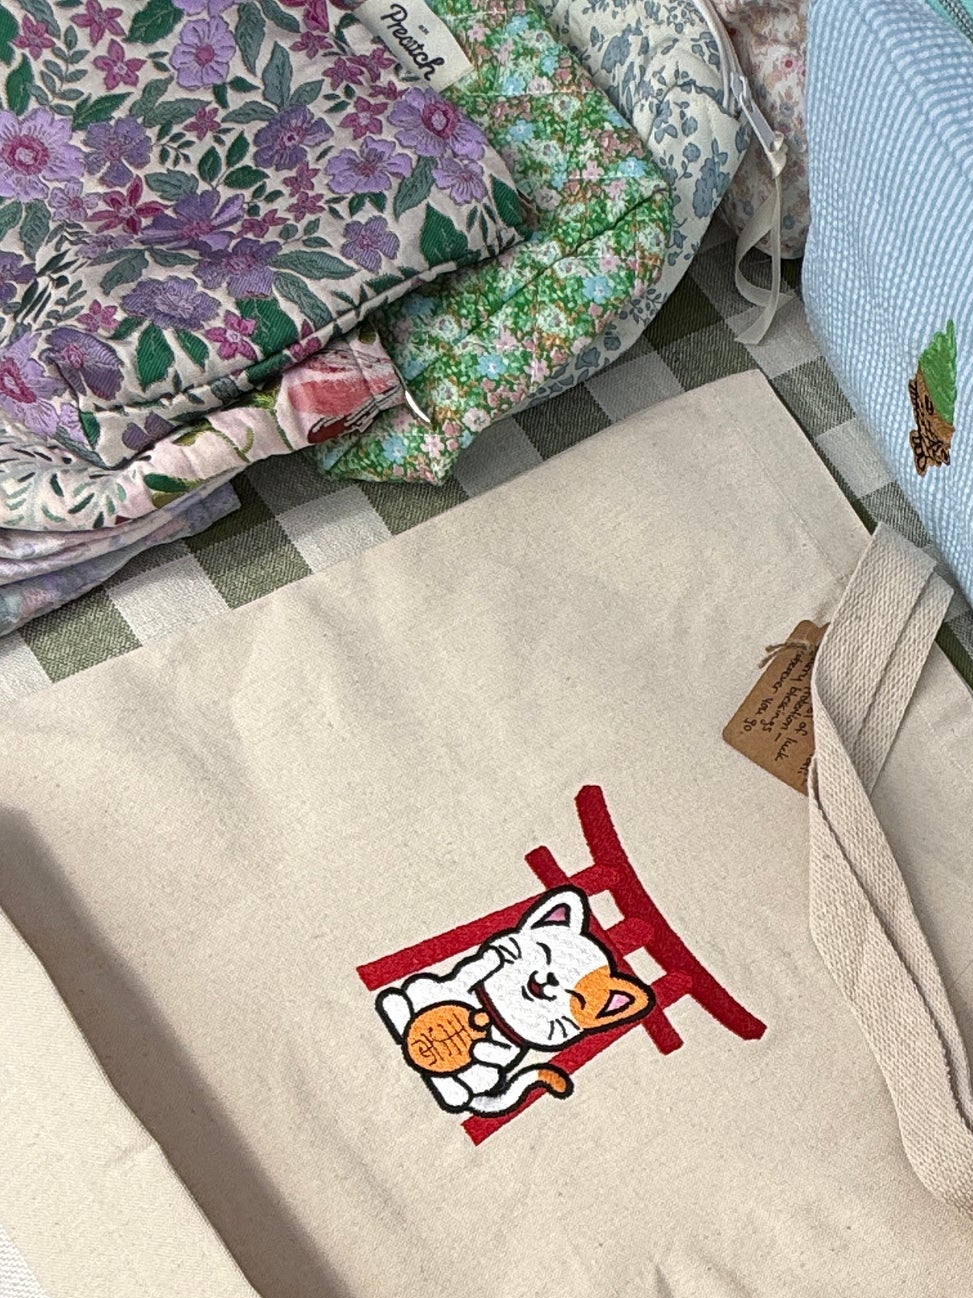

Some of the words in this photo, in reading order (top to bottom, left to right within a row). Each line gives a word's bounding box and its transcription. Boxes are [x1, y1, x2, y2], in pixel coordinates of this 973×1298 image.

[760, 686, 802, 733] blessings
[794, 721, 808, 736] of
[774, 737, 798, 761] luck
